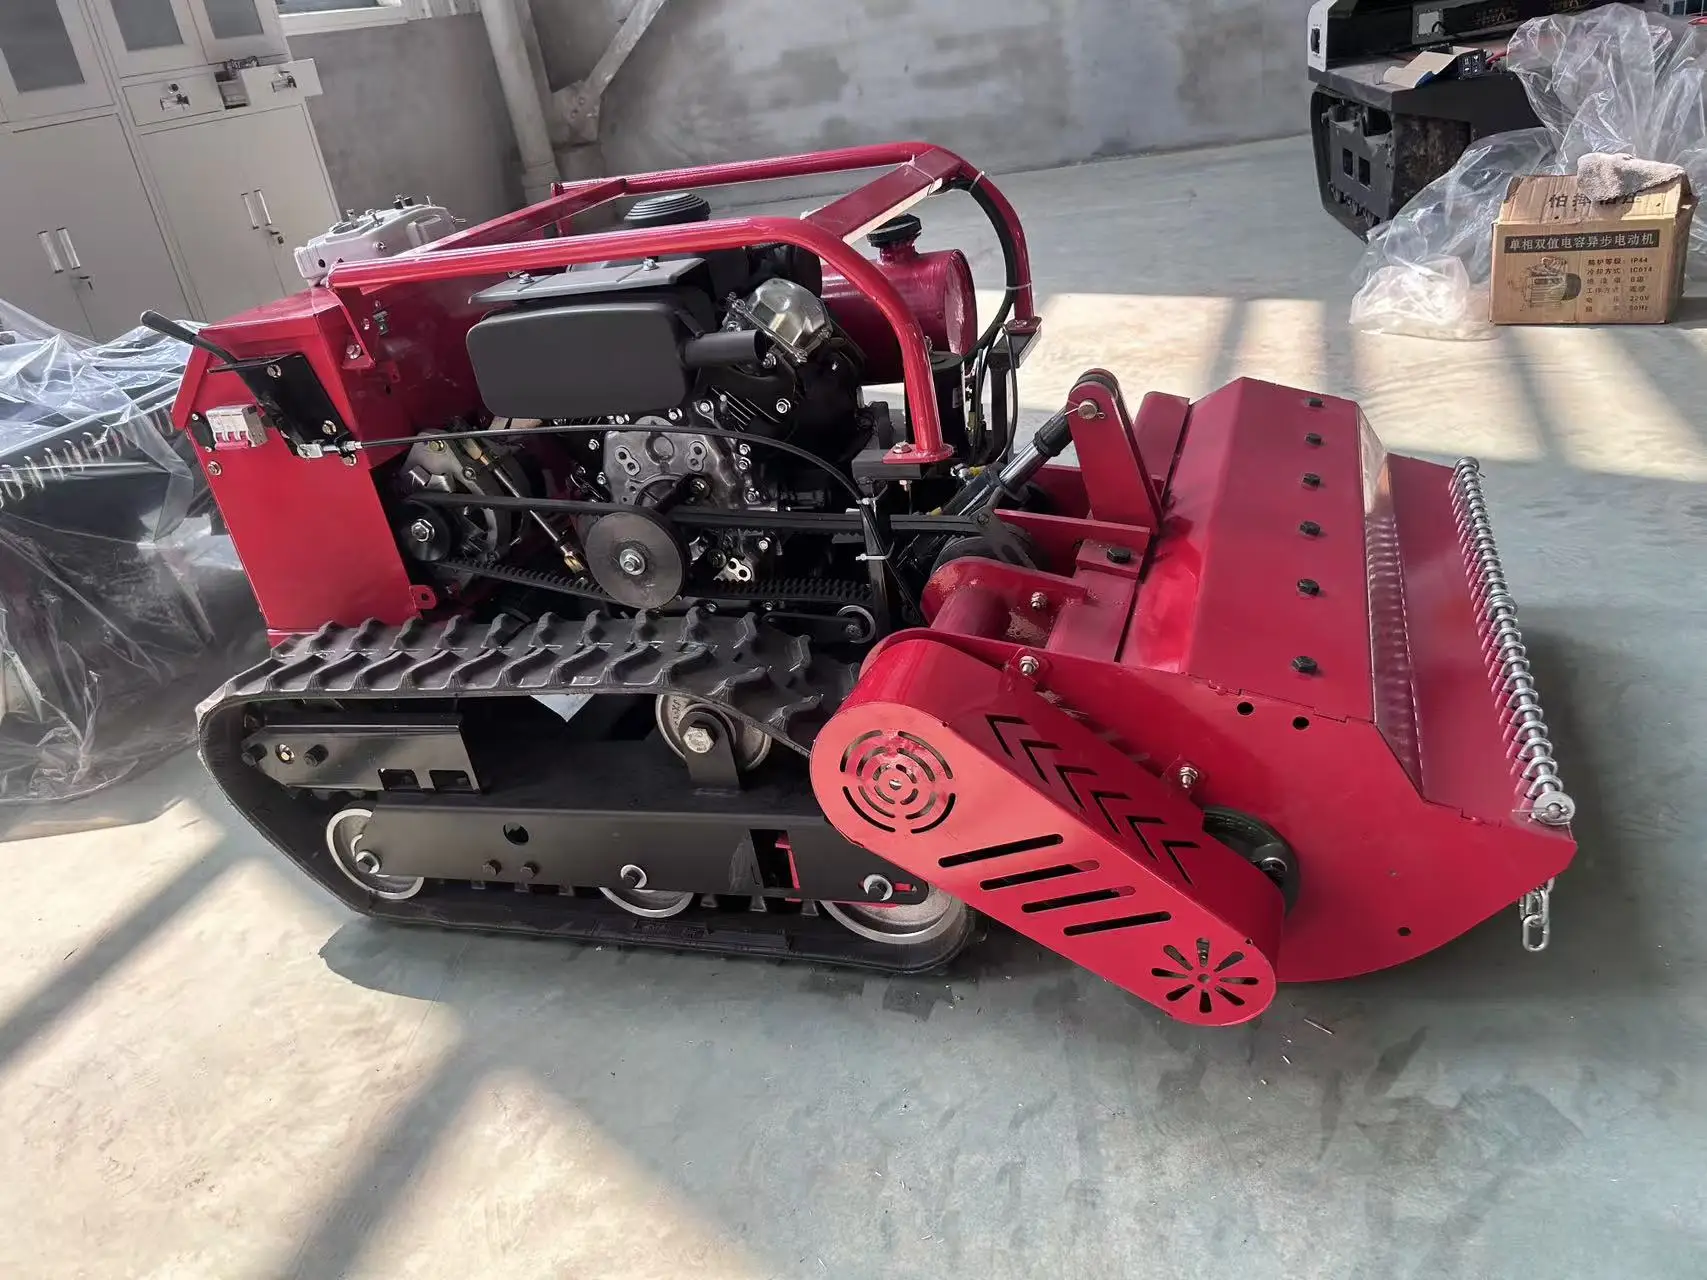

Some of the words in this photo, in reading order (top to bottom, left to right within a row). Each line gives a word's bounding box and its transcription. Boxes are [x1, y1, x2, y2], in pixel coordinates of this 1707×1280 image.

[1509, 233, 1654, 250] 单相双值电容异步电动机
